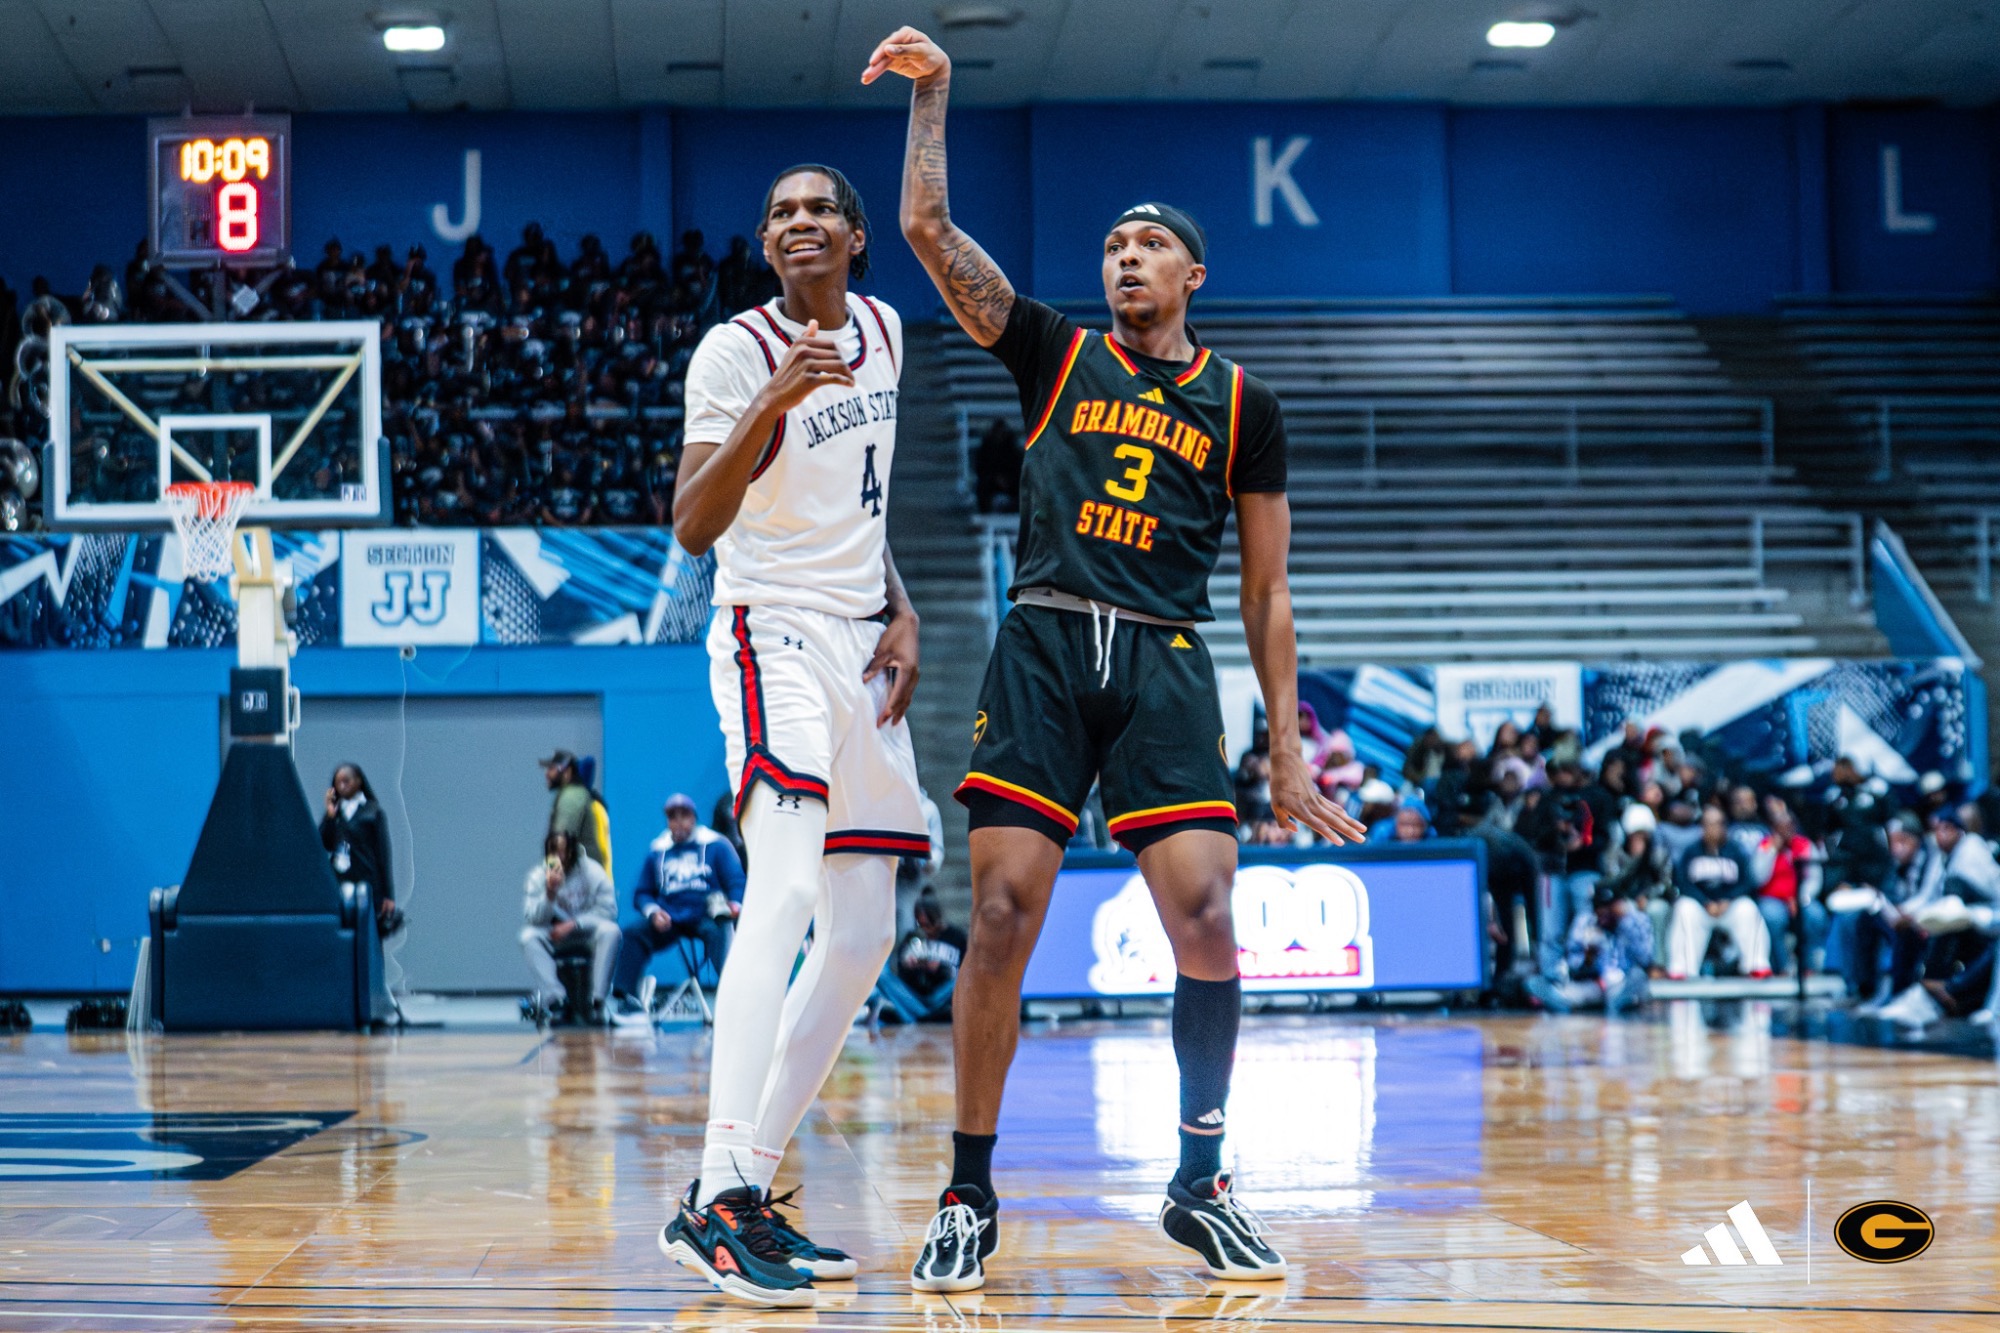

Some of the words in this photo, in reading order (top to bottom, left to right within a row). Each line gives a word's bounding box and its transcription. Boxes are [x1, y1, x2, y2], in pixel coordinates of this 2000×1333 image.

[181, 138, 269, 183] 10:09
[1254, 136, 1320, 225] K
[1882, 146, 1935, 231] L
[218, 182, 258, 252] 8
[432, 149, 481, 242] J
[802, 396, 868, 449] JACKSON
[868, 389, 900, 422] STAT
[1070, 400, 1213, 471] GRAMBLING
[861, 443, 882, 518] 4
[1104, 443, 1155, 502] 3
[367, 543, 456, 567] SECTION
[1076, 500, 1160, 551] STATE
[371, 570, 451, 627] JJ
